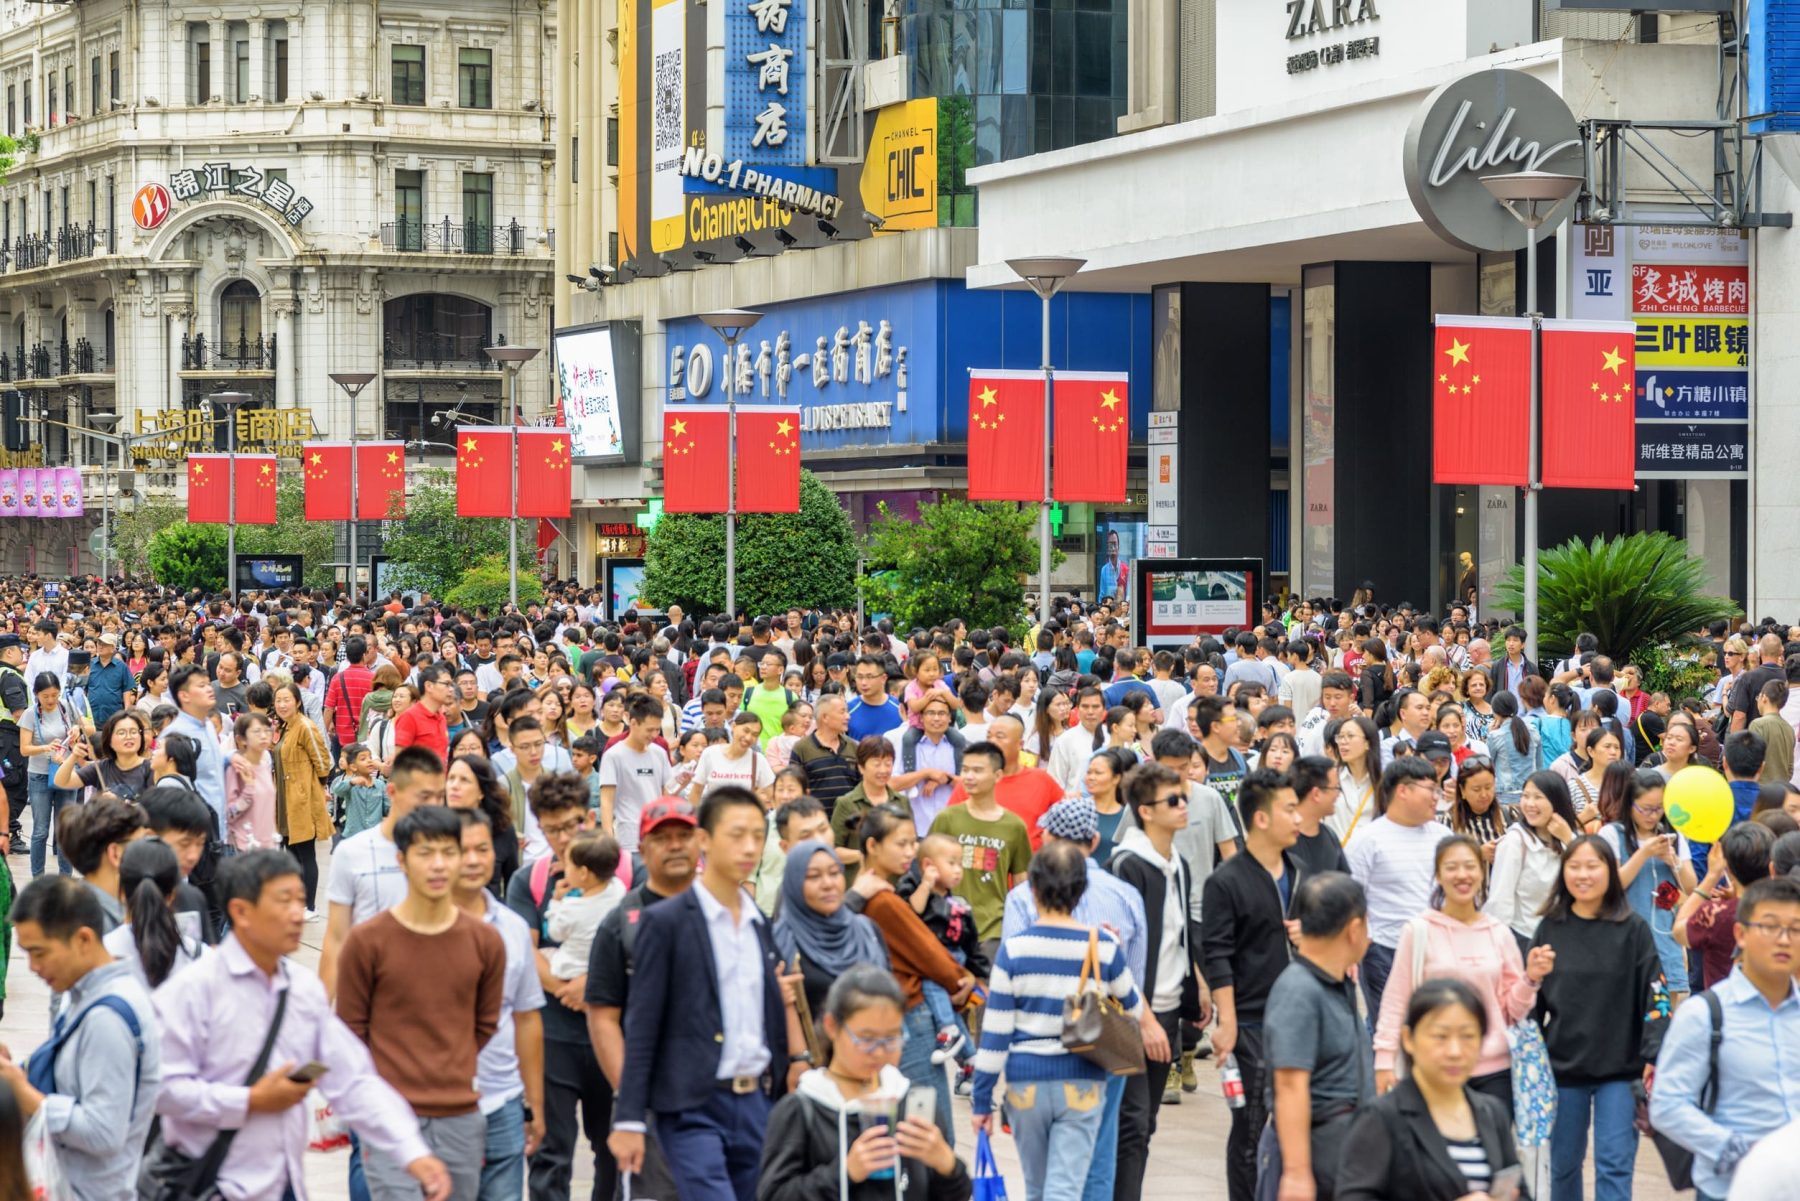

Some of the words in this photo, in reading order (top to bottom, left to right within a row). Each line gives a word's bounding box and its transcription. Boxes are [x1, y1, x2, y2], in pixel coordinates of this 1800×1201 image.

[1285, 0, 1380, 39] ZARA
[891, 127, 919, 141] CHANNEL
[683, 146, 743, 190] NO.1
[742, 168, 845, 219] PHARMACY
[888, 145, 925, 203] CHIC
[170, 162, 295, 214] 锦江之星
[1633, 266, 1647, 276] 6F
[1585, 269, 1613, 297] 亚
[1635, 268, 1746, 304] 炙城烤肉
[1640, 304, 1658, 312] ZHI
[1662, 304, 1698, 312] CHENG
[1703, 305, 1746, 313] BARBECUE
[1636, 324, 1749, 353] 三叶眼镜
[1676, 385, 1747, 403] 方糖小镇
[264, 444, 304, 458] STOR
[1641, 443, 1744, 460] 斯维登精品公寓
[1310, 504, 1328, 512] ZARA
[1487, 499, 1507, 509] ZARA
